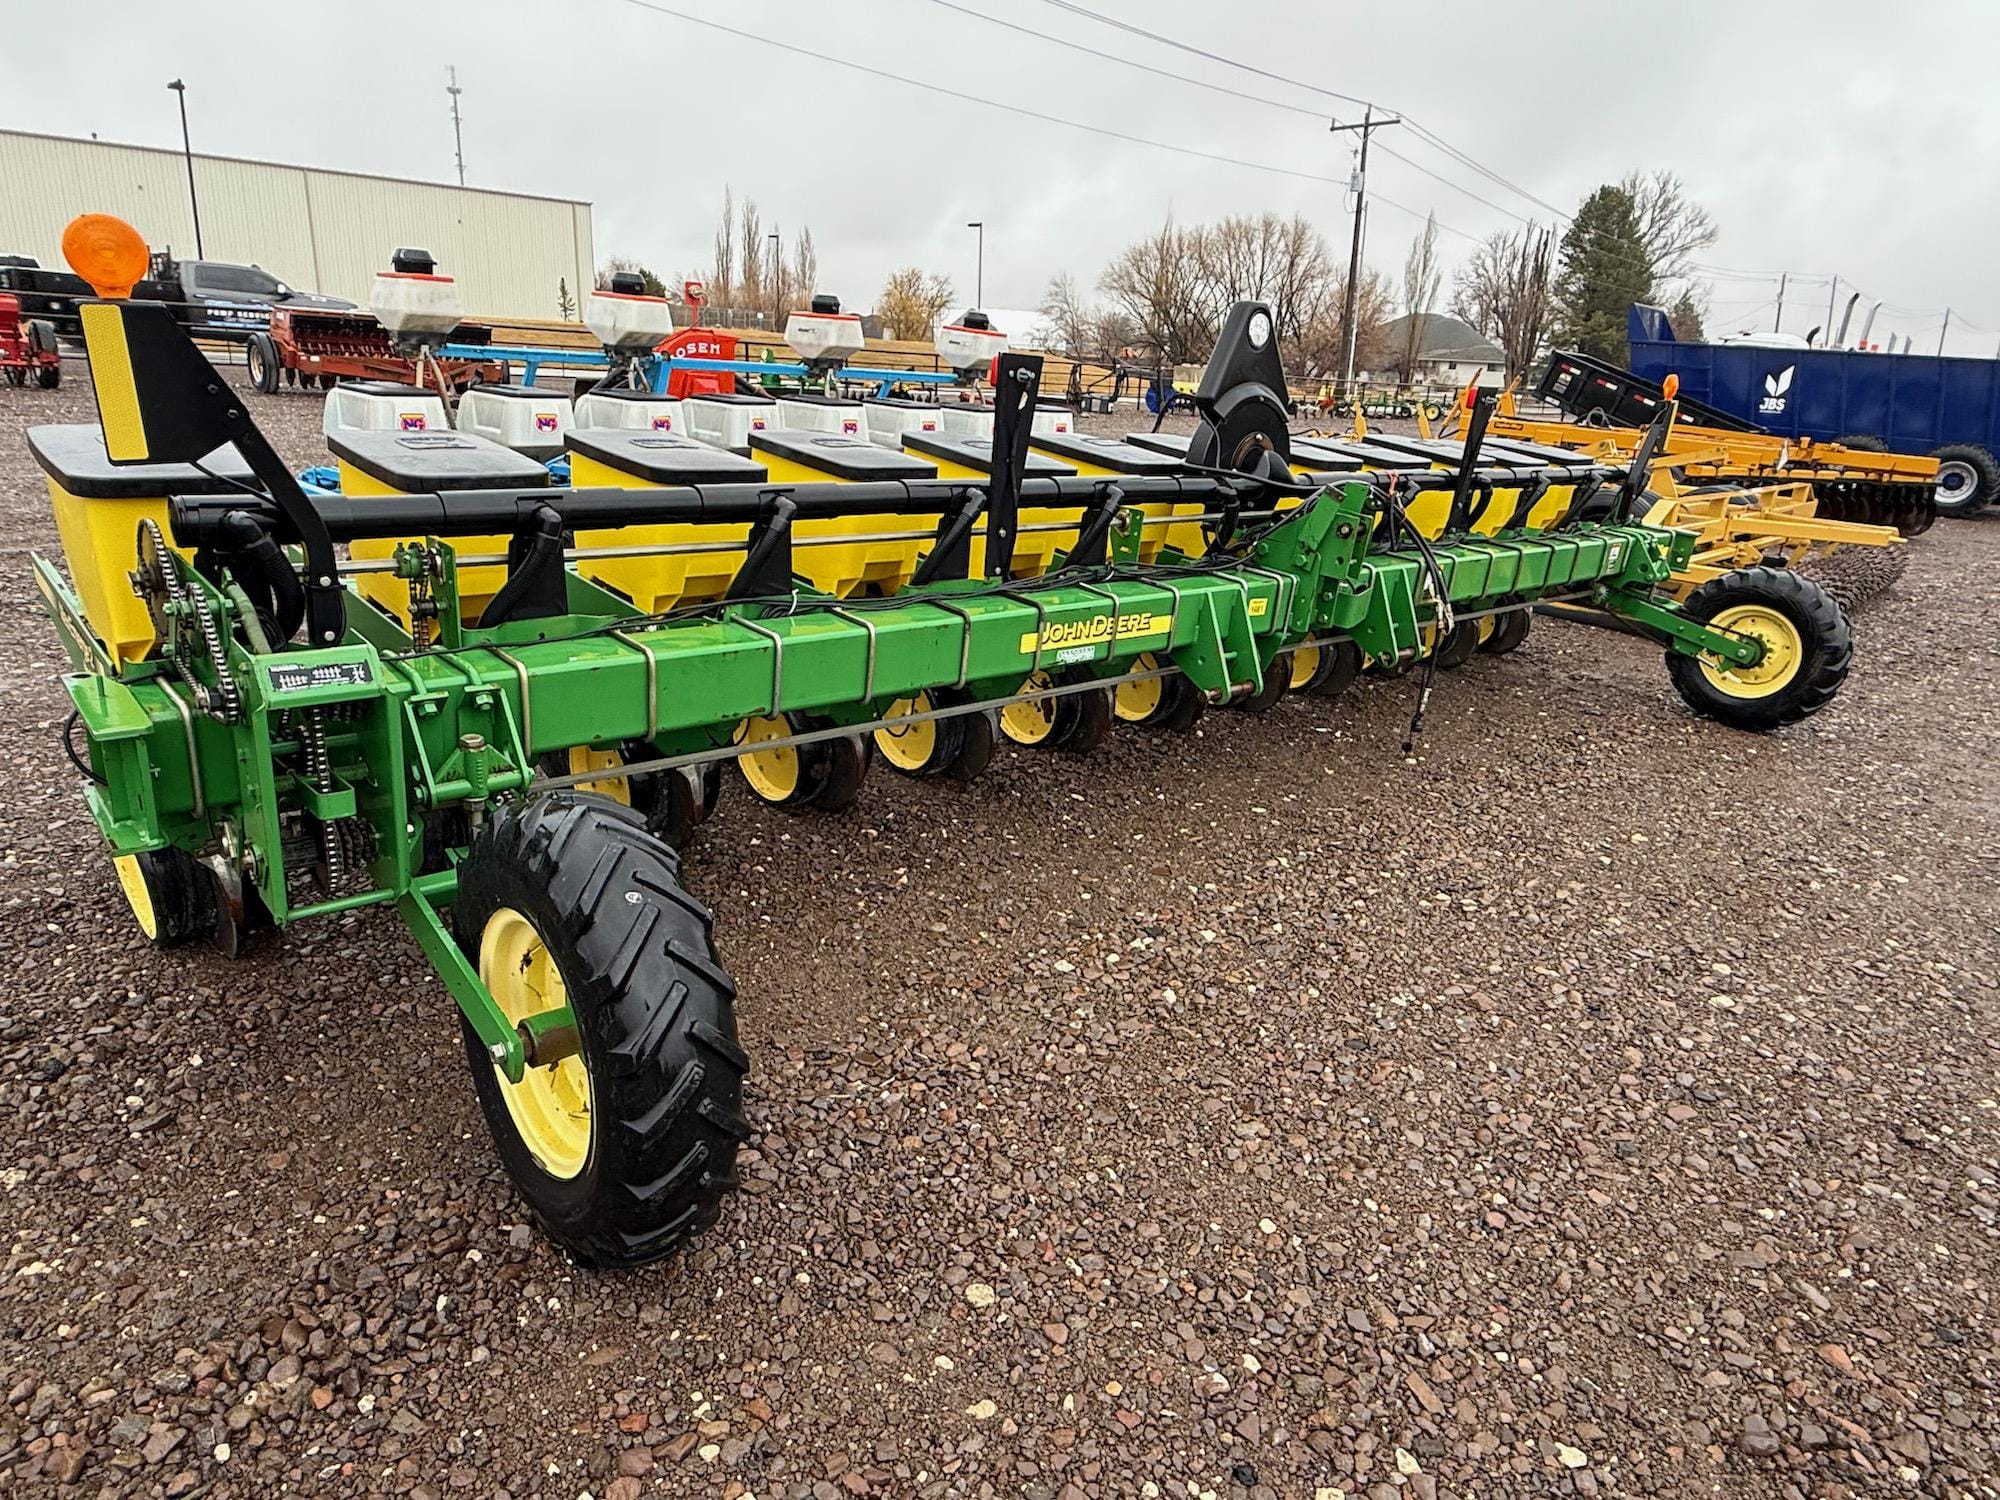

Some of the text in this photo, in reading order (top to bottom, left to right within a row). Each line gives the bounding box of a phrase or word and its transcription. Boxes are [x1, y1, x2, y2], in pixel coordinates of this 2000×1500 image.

[236, 311, 270, 320] SERVIC
[674, 342, 720, 358] OSEM
[1758, 397, 1786, 411] JBS
[1041, 613, 1152, 645] JOHN DEERE
